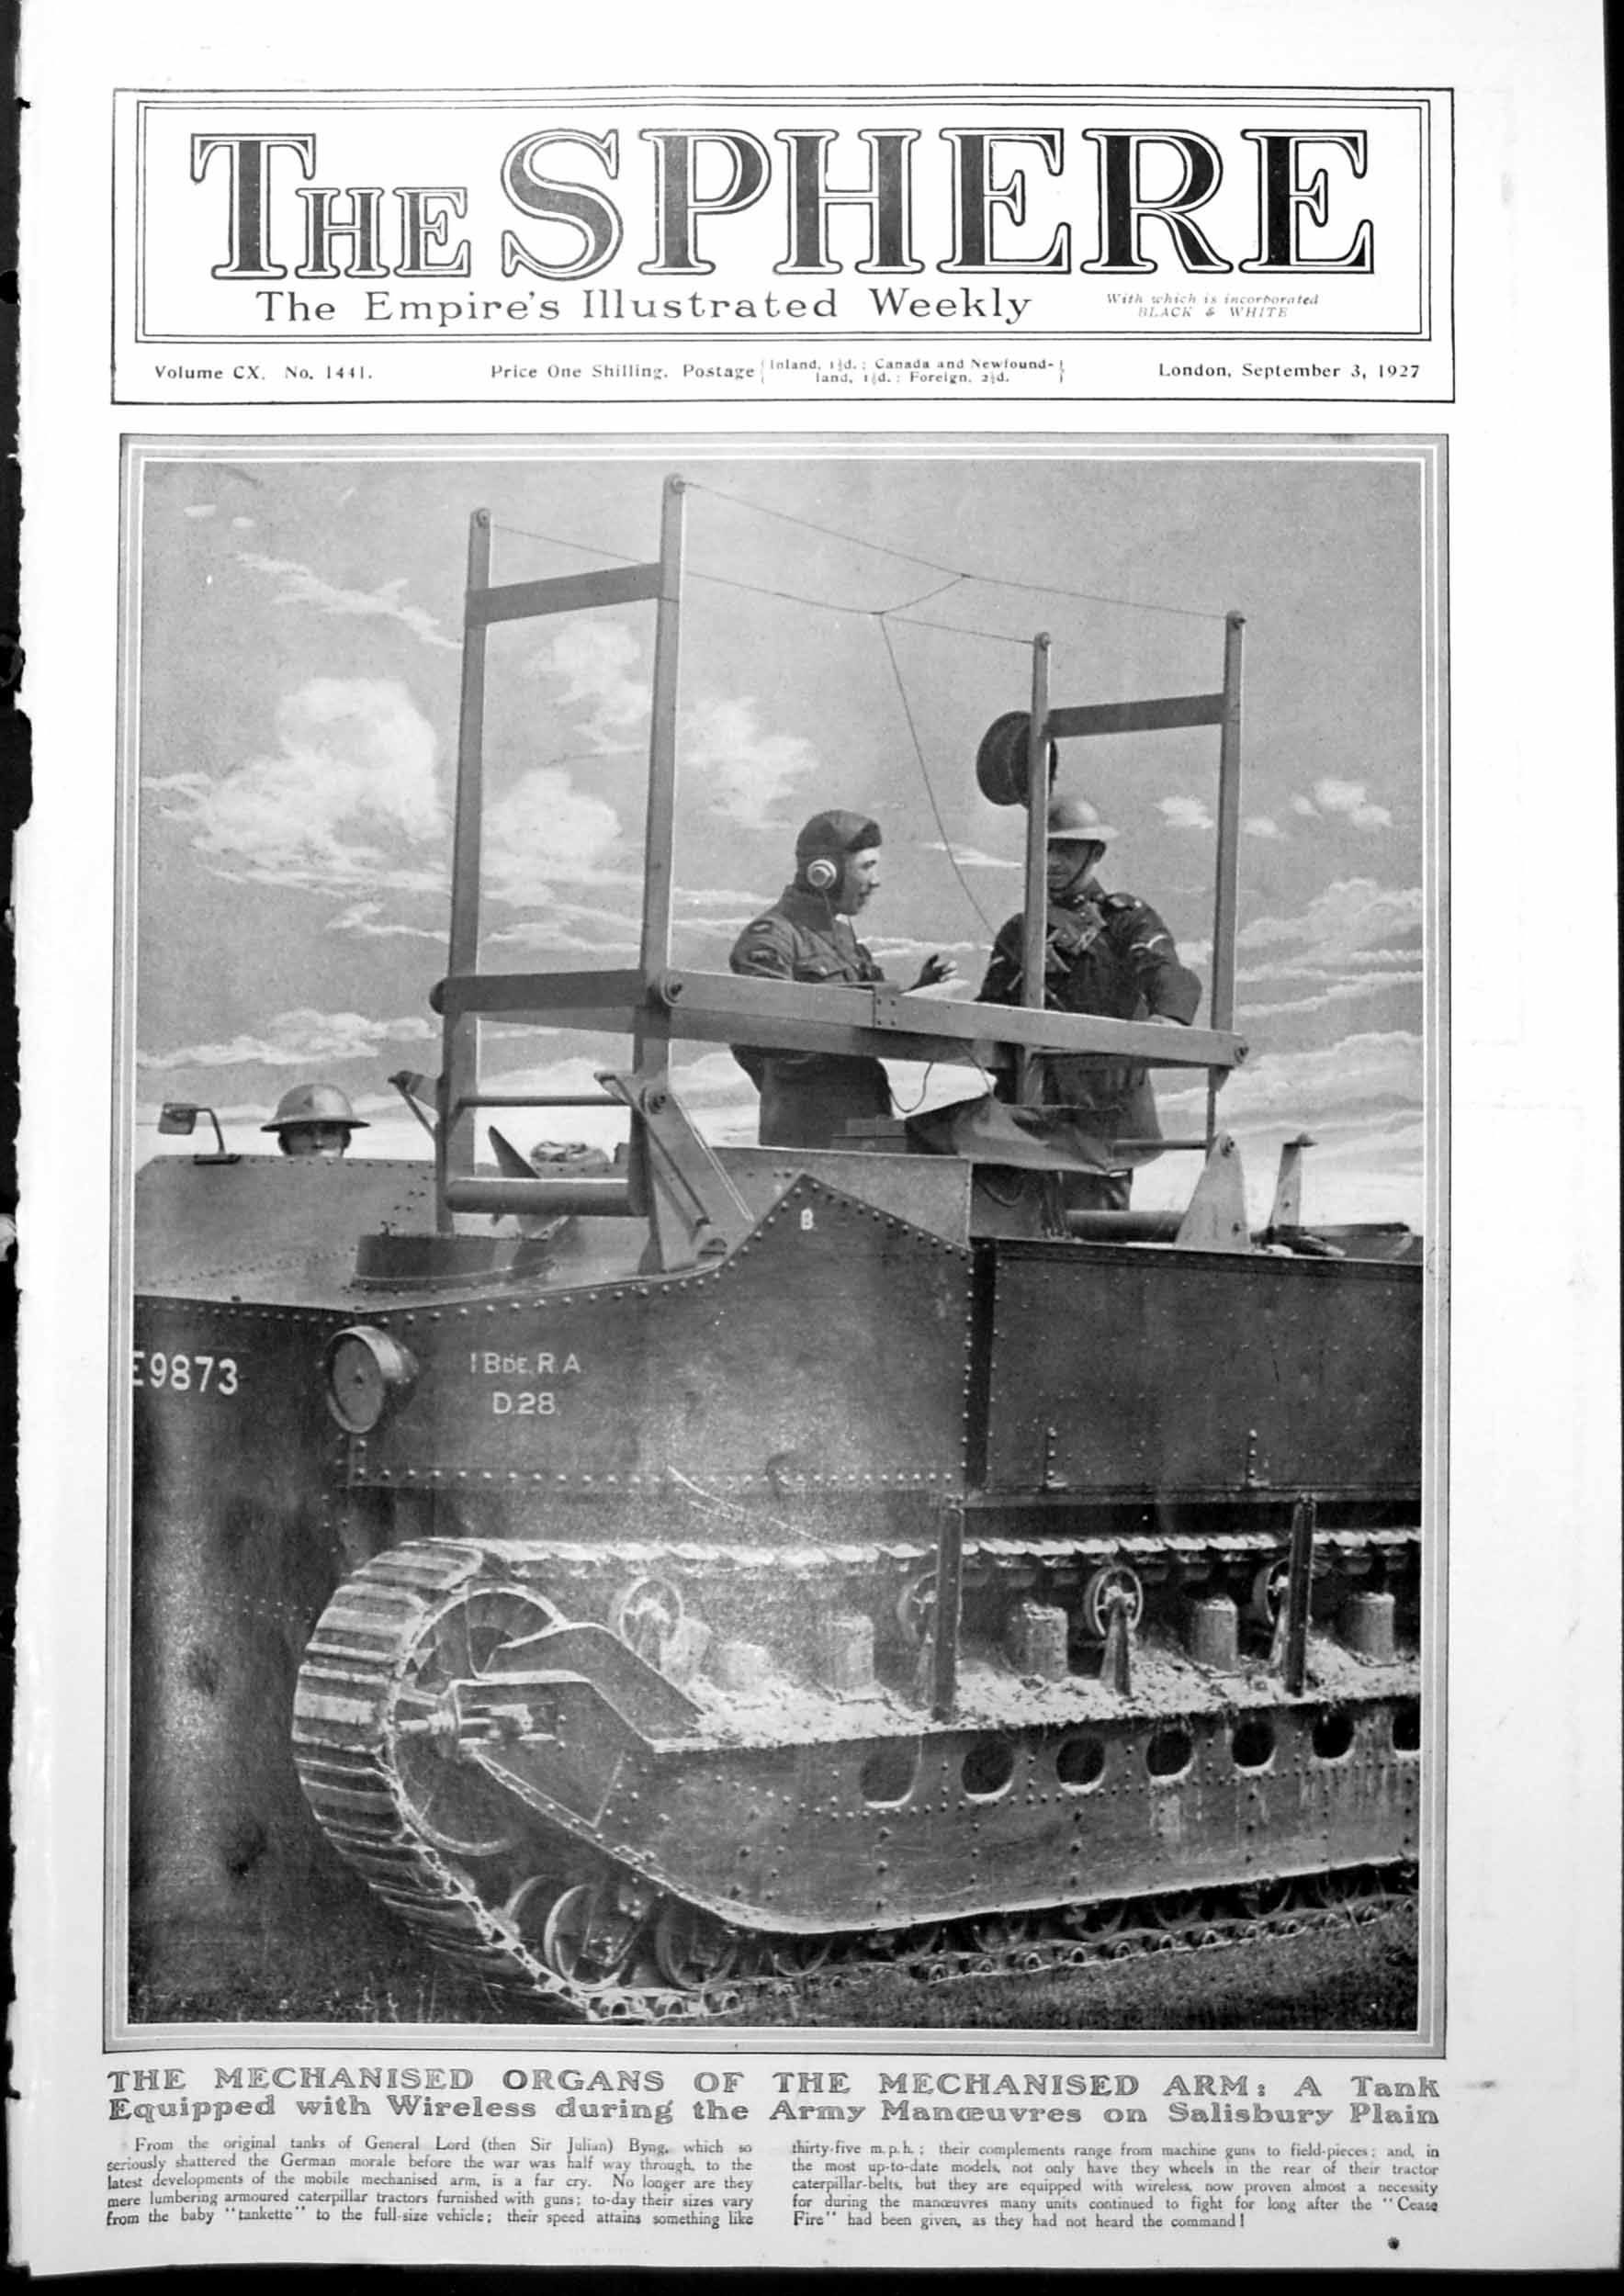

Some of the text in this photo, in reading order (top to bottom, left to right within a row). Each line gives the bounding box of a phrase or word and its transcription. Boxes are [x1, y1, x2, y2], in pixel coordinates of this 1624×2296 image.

[499, 127, 1375, 281] SPHERE
[254, 287, 1032, 329] The Empire's Illustrated Weekly
[1106, 292, 1320, 307] With which is incorporated
[1138, 306, 1288, 319] BLACK & WHITE
[154, 365, 372, 381] Volume CX. No. 1441.
[491, 364, 537, 379] Price
[547, 364, 581, 378] One
[682, 363, 755, 380] Postage
[874, 357, 930, 370] Canada
[936, 358, 964, 369] and
[1158, 362, 1420, 380] London, September 3, 1927
[106, 2066, 1440, 2098] THE MECHANISED ORGANS OF THE MECHANISED ARM: A Tank
[108, 2094, 276, 2123] Equipped
[295, 2094, 372, 2117] with
[388, 2093, 537, 2119] Wireless
[554, 2095, 674, 2124] during
[692, 2098, 750, 2122] the
[769, 2099, 867, 2125] Army
[1102, 2105, 1148, 2124] on
[1167, 2100, 1335, 2127] Salisbury
[1349, 2102, 1440, 2125] Plain
[134, 2133, 725, 2158] From the original tanks of General Lord (then Sir Julian) which
[791, 2138, 1441, 2163] thirty-five their complements range machine guns in
[106, 2150, 753, 2177] seriously shattered the German morale before the war was half way to the
[824, 2156, 1440, 2178] most up-to-date not only have they wheels rear tractor
[107, 2173, 144, 2191] latest
[151, 2167, 245, 2190] developments
[251, 2169, 265, 2186] of
[303, 2169, 351, 2187] mobile
[360, 2170, 439, 2187] mechanised
[534, 2171, 557, 2188] far
[612, 2170, 636, 2189] No
[641, 2173, 687, 2195] longer
[693, 2179, 717, 2190] are
[723, 2174, 755, 2194] they
[914, 2174, 938, 2191] but
[947, 2176, 978, 2196] they
[1019, 2176, 1082, 2197] equipped
[1204, 2182, 1235, 2193] now
[1244, 2182, 1292, 2198] proven
[1302, 2177, 1348, 2193] almost
[1377, 2181, 1439, 2198] necessity
[106, 2187, 755, 2212] mere lumbering armoured caterpillar tractors furnished with to-day their sizes vary
[791, 2191, 814, 2210] for
[823, 2190, 869, 2212] during
[998, 2199, 1038, 2214] many
[1044, 2198, 1078, 2211] units
[1088, 2194, 1155, 2211] continued
[1190, 2194, 1224, 2214] fight
[1267, 2194, 1297, 2214] long
[1305, 2194, 1340, 2212] after
[105, 2204, 755, 2231] from baby to full-size their speed attains something like
[846, 2210, 1135, 2229] had been heard
